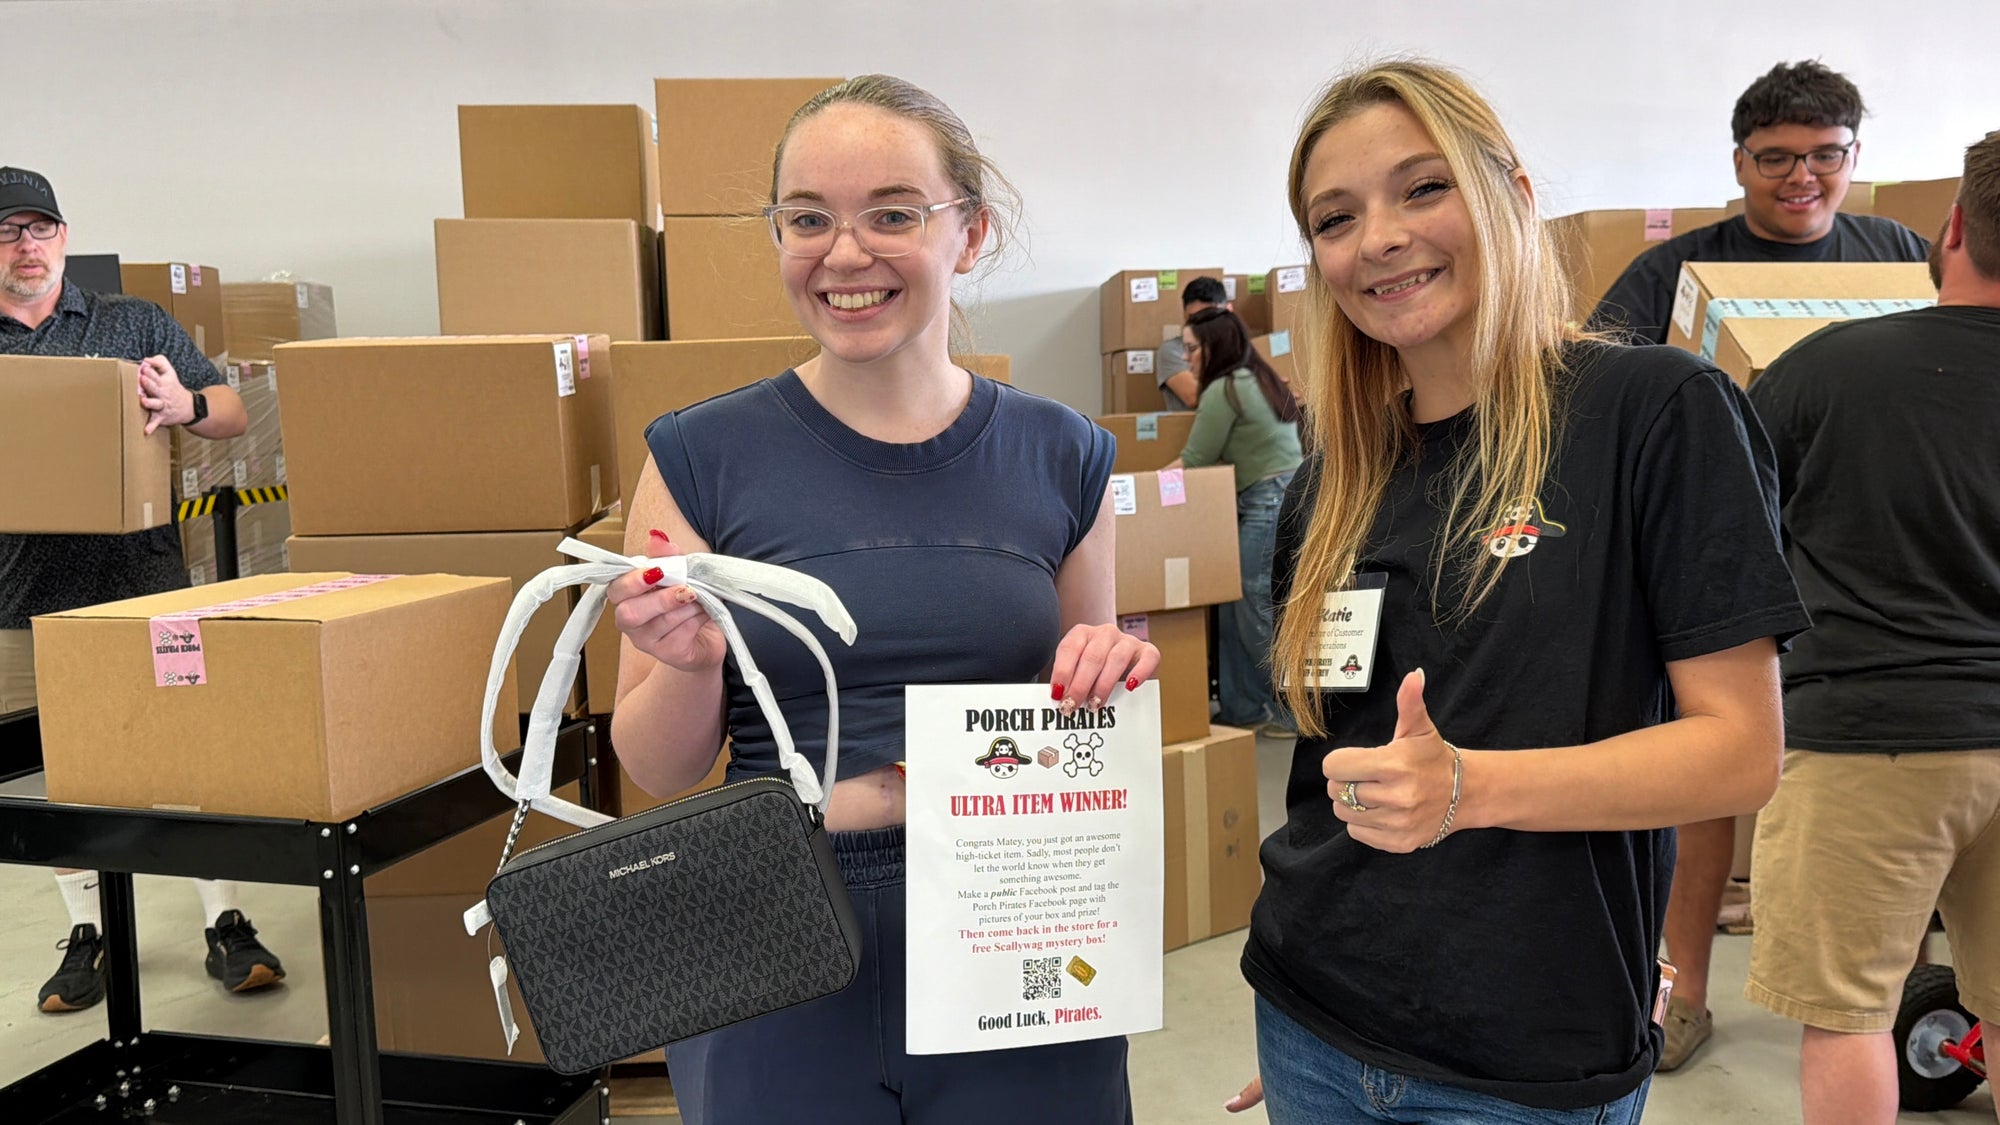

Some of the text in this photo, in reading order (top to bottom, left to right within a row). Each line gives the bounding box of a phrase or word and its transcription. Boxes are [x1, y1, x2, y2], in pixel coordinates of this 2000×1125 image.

[1317, 640, 1347, 652] perations
[965, 706, 1116, 732] PORCH PIRATES
[950, 788, 1128, 816] ULTRA ITEM WINNER!
[955, 838, 994, 849] Congrats
[996, 837, 1025, 847] Matey,
[1026, 838, 1042, 847] you
[1043, 836, 1058, 846] just
[1060, 835, 1073, 845] got
[1086, 832, 1121, 842] awesome
[955, 850, 1001, 862] high-ticket
[1003, 849, 1024, 859] item.
[1026, 848, 1051, 859] Sadly,
[1053, 847, 1072, 856] most
[1074, 845, 1100, 857] people
[609, 852, 675, 878] MICHAEL KORS
[973, 858, 1106, 873] let the world know when they get
[999, 872, 1082, 885] something awesome.
[957, 889, 982, 899] Make
[990, 888, 1018, 900] public
[1019, 885, 1058, 896] Facebook
[1060, 885, 1076, 895] post
[1078, 882, 1092, 892] and
[1094, 883, 1106, 892] tag
[1107, 881, 1120, 890] the
[972, 894, 1106, 912] Porch Pirates Facebook page with
[978, 906, 1100, 926] pictures of your box and prize!
[958, 920, 1118, 939] Then come back in the store for a
[972, 933, 1106, 954] free Scallywag mystery box!
[978, 1005, 1102, 1031] Good Luck, Pirates.
